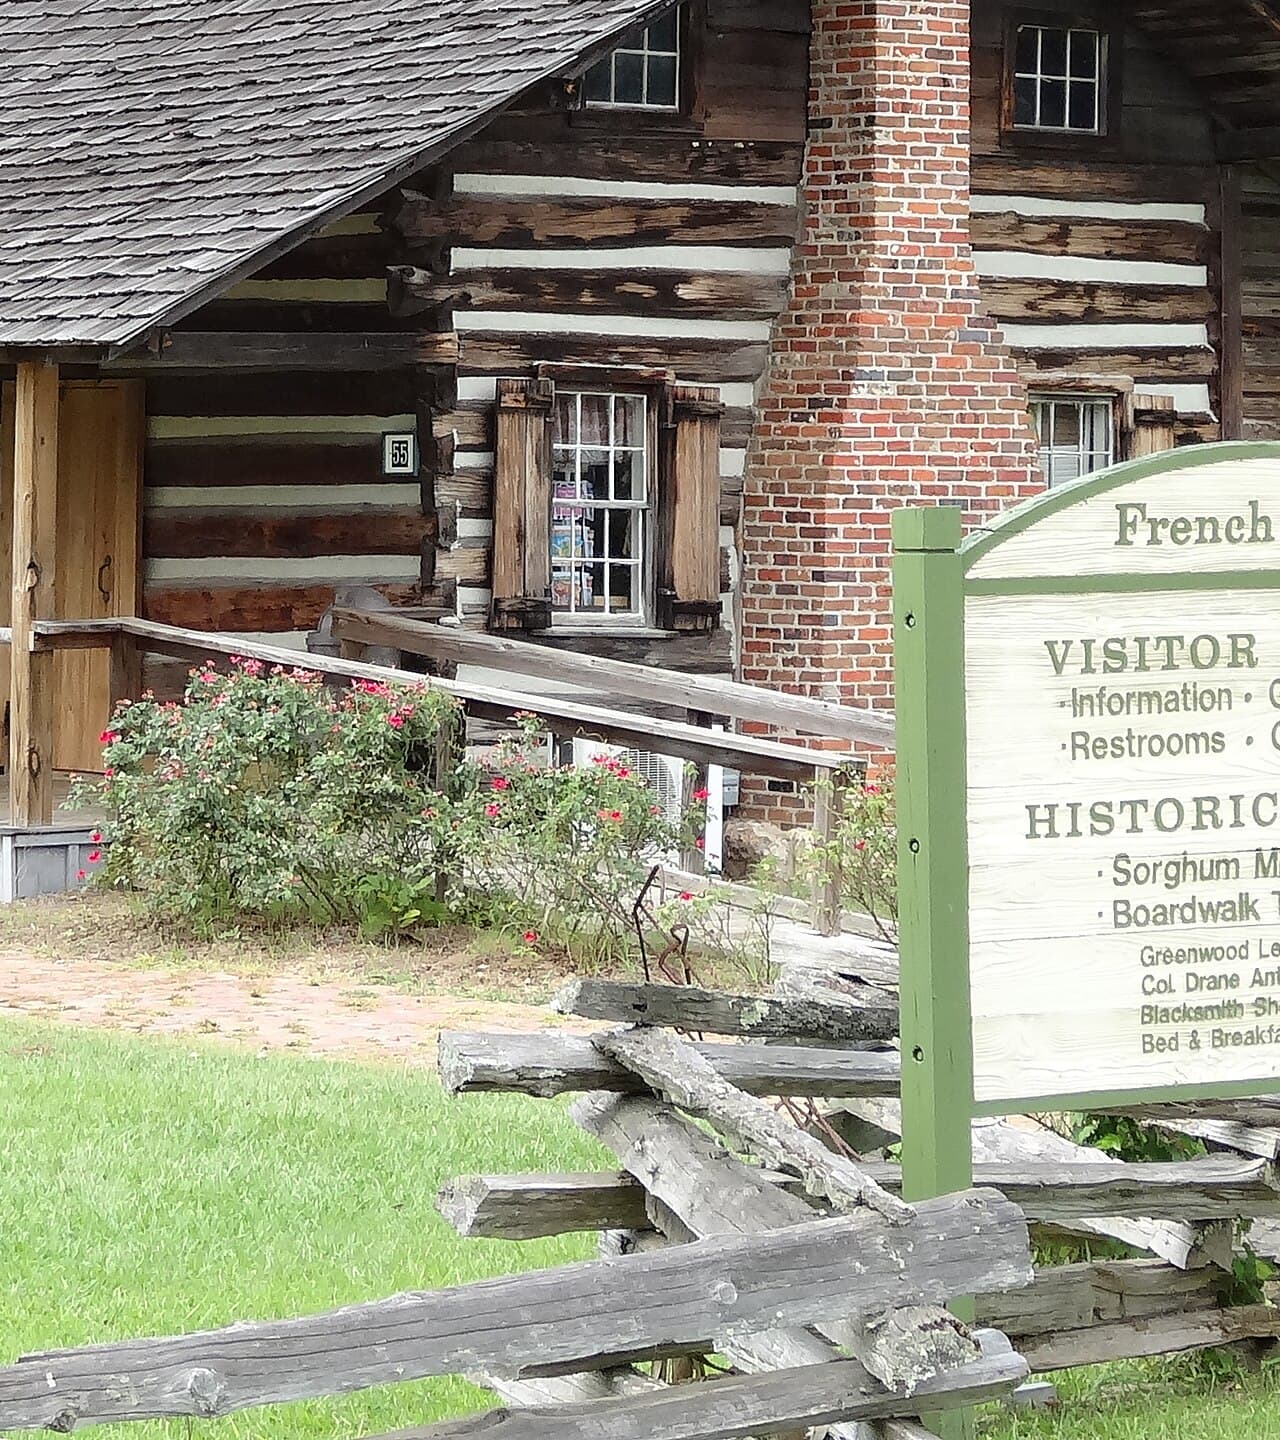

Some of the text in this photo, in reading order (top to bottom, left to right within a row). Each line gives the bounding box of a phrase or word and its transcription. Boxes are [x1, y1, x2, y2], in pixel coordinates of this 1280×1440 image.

[392, 442, 408, 465] 55
[1114, 500, 1274, 547] French
[1044, 633, 1259, 676] VISITOR
[1071, 681, 1233, 718] Information
[1071, 728, 1226, 761] Restrooms
[1112, 851, 1241, 890] Sorghum
[1113, 893, 1260, 929] Boardwalk
[1140, 939, 1250, 967] Greenwood
[1185, 971, 1240, 993] Drane
[1140, 999, 1245, 1025] Blacksmith
[1142, 1032, 1179, 1054] Bed
[1189, 1029, 1201, 1051] &
